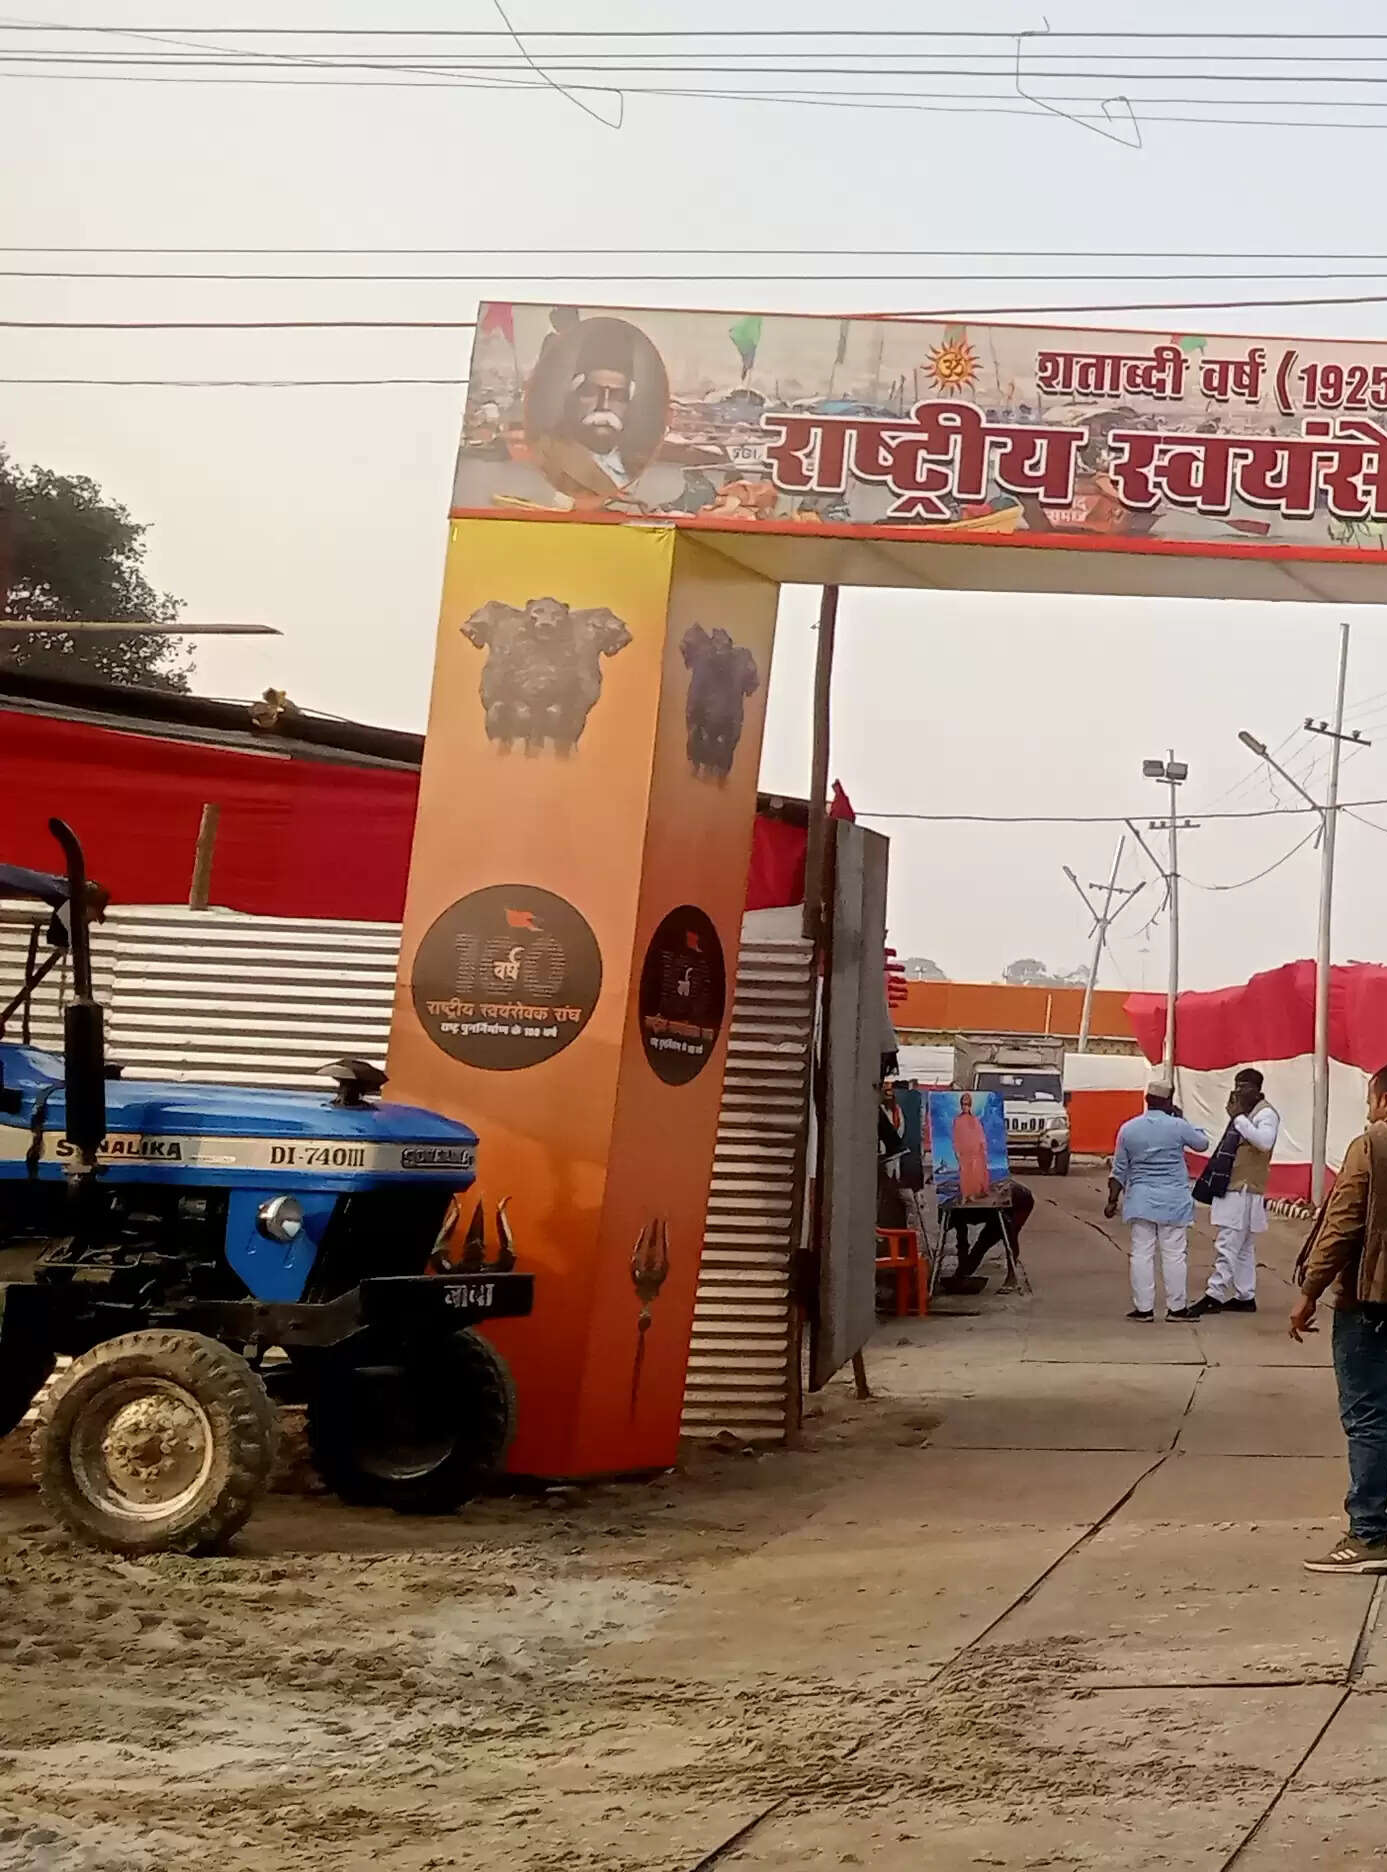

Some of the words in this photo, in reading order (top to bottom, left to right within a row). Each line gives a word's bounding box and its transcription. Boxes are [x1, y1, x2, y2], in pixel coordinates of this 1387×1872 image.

[1036, 345, 1189, 400] शताब्दी
[1200, 348, 1266, 402] वर्ष
[761, 400, 1088, 519] राष्ट्रीय
[426, 997, 475, 1019] राष्ट्रीय
[480, 1001, 548, 1021] स्वयंसेवक
[56, 1139, 182, 1161] SNALIKA
